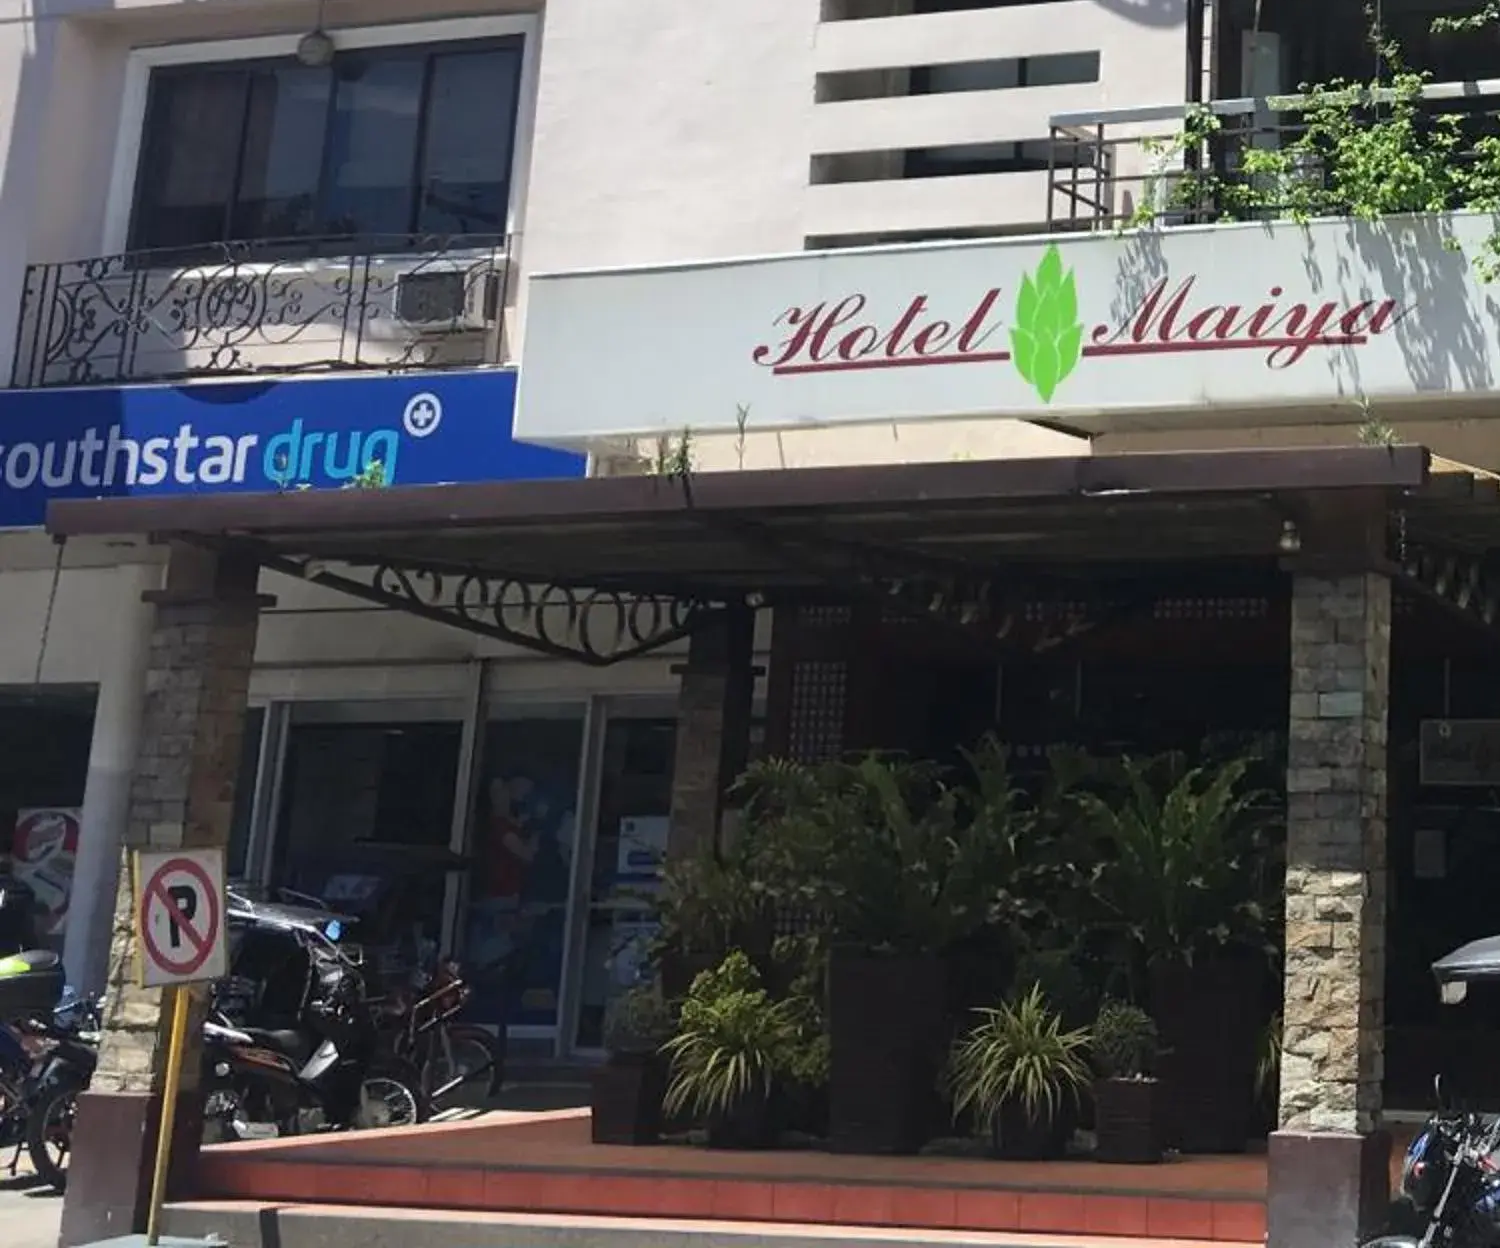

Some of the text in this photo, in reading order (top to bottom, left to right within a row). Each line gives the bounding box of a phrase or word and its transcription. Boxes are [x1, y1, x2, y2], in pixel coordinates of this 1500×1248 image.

[753, 274, 1414, 370] Hotel Maiya
[0, 423, 258, 488] outhstar
[167, 885, 197, 948] P
